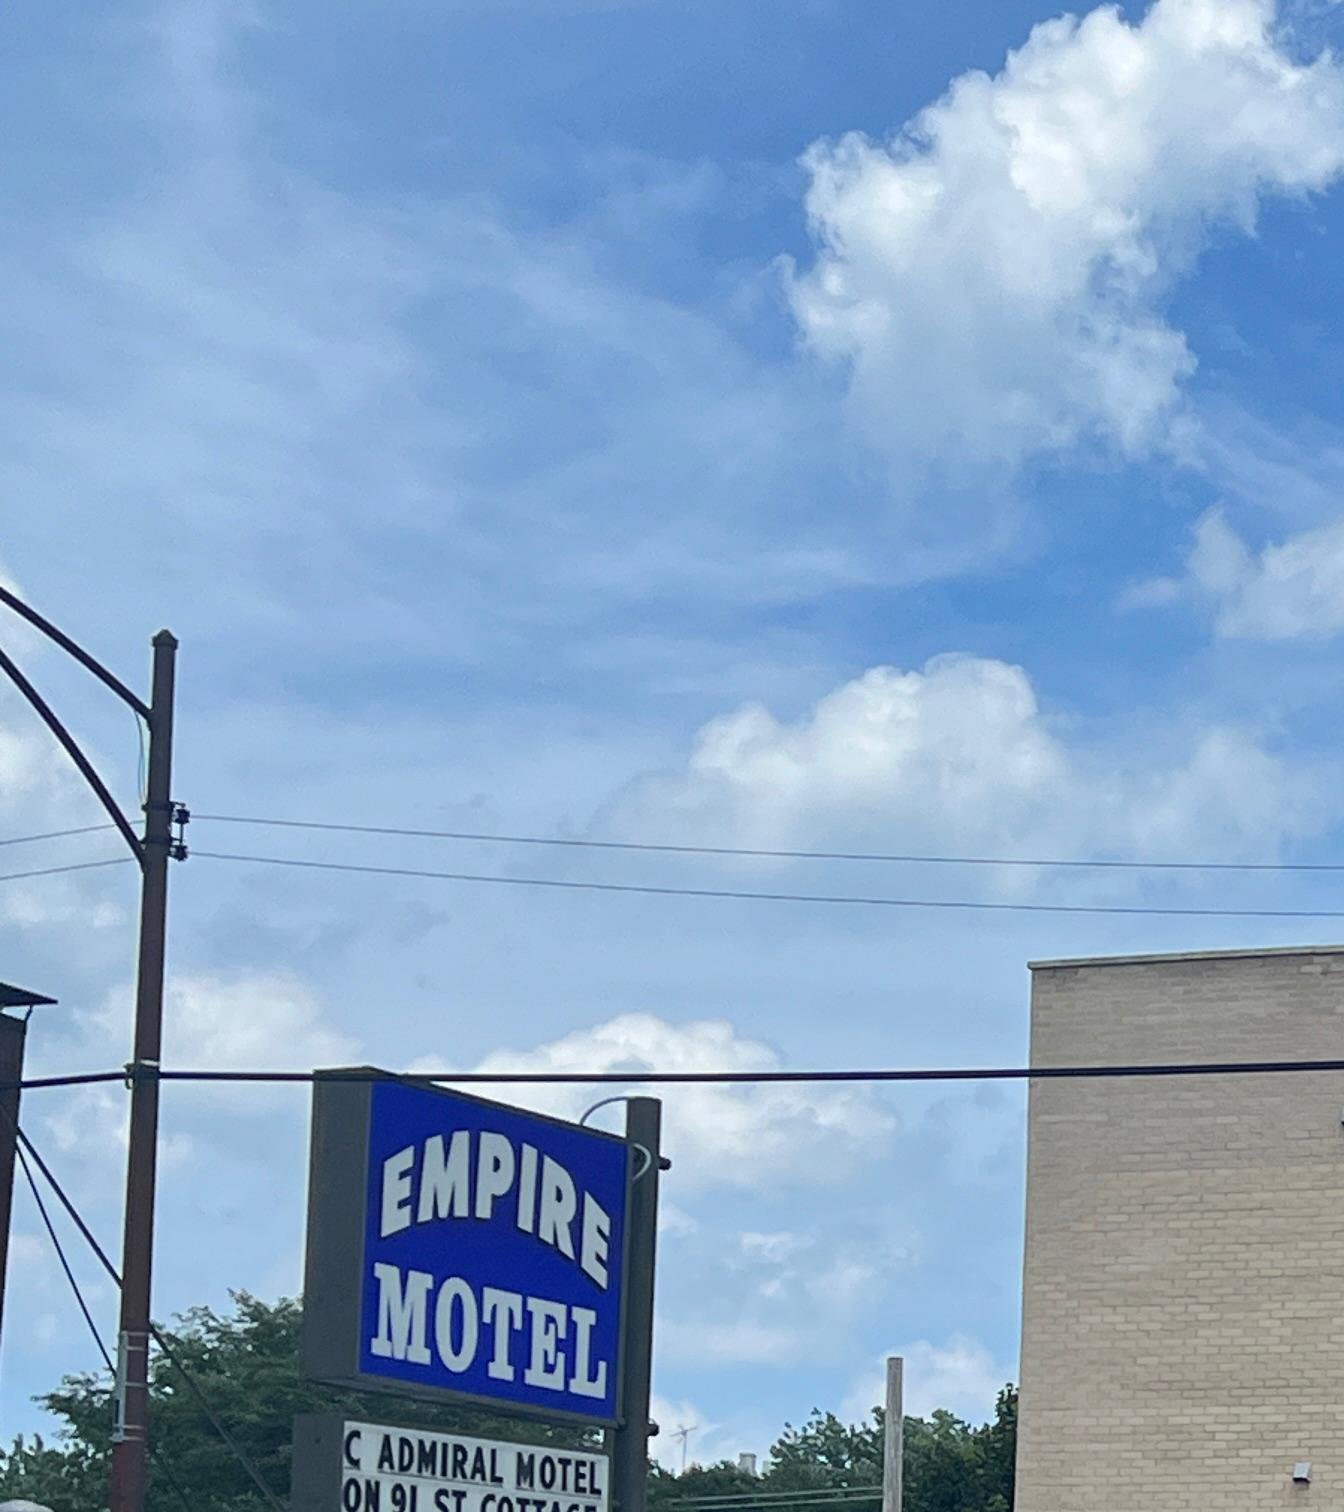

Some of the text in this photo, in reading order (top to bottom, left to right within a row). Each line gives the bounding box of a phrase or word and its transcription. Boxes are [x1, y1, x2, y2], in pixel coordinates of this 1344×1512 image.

[380, 1130, 611, 1290] EMPIRE
[371, 1262, 607, 1399] MOTEL
[345, 1430, 602, 1496] C ADMIRAL MOTEL
